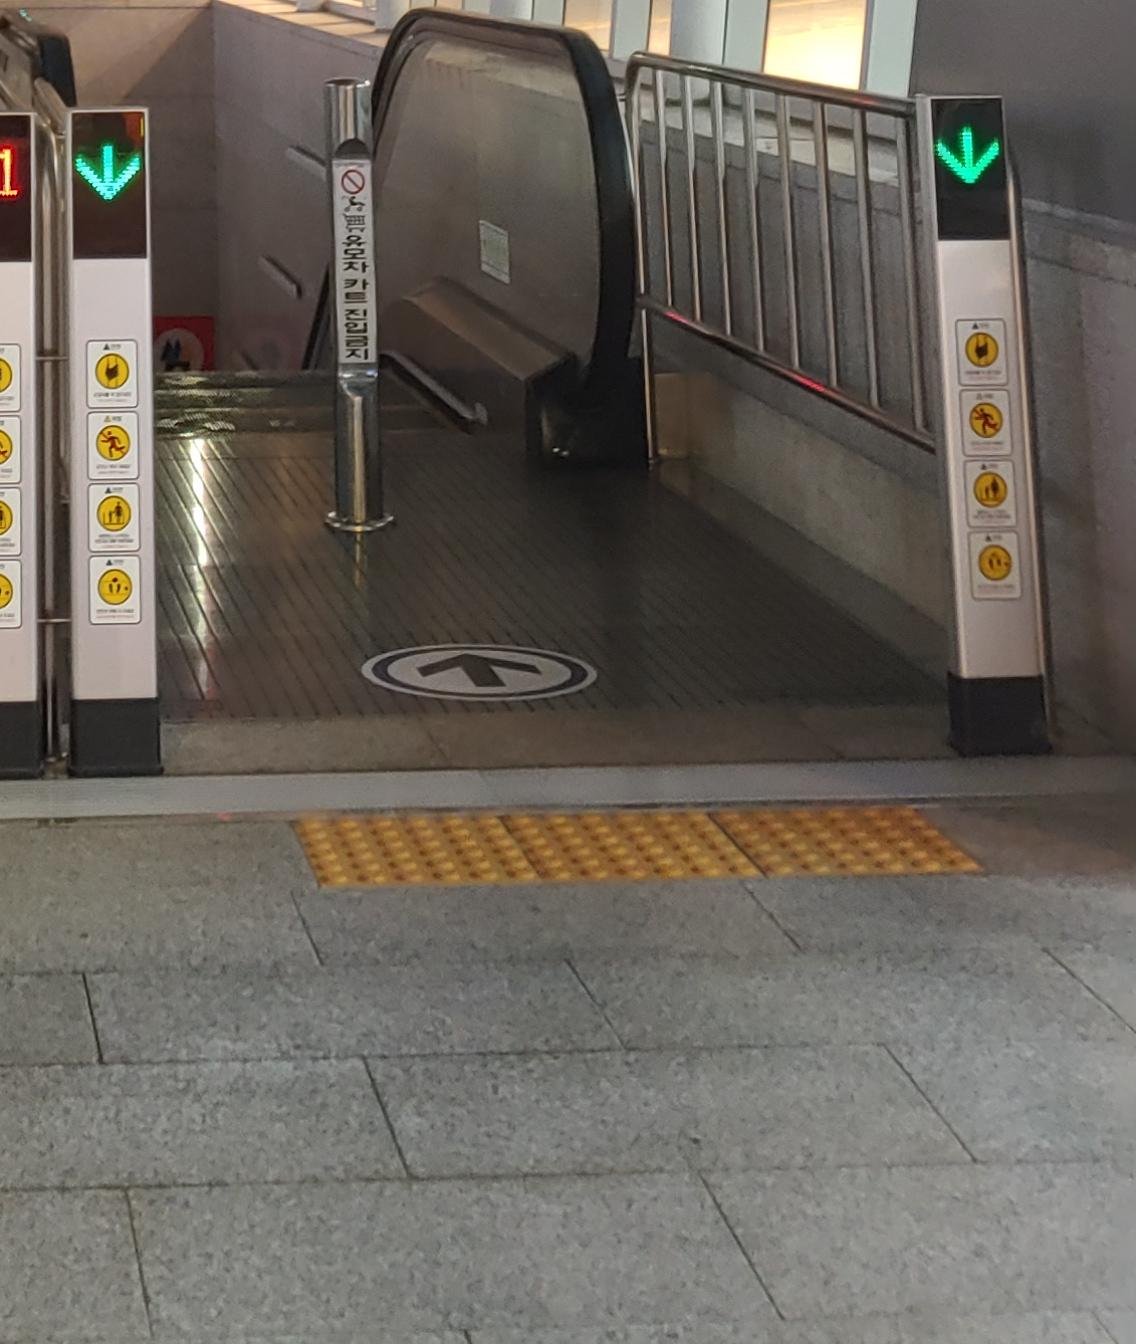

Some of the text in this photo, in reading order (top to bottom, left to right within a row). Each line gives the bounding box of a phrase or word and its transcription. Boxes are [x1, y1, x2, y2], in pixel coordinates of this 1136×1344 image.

[342, 234, 369, 361] 유모차 카트 진입금지
